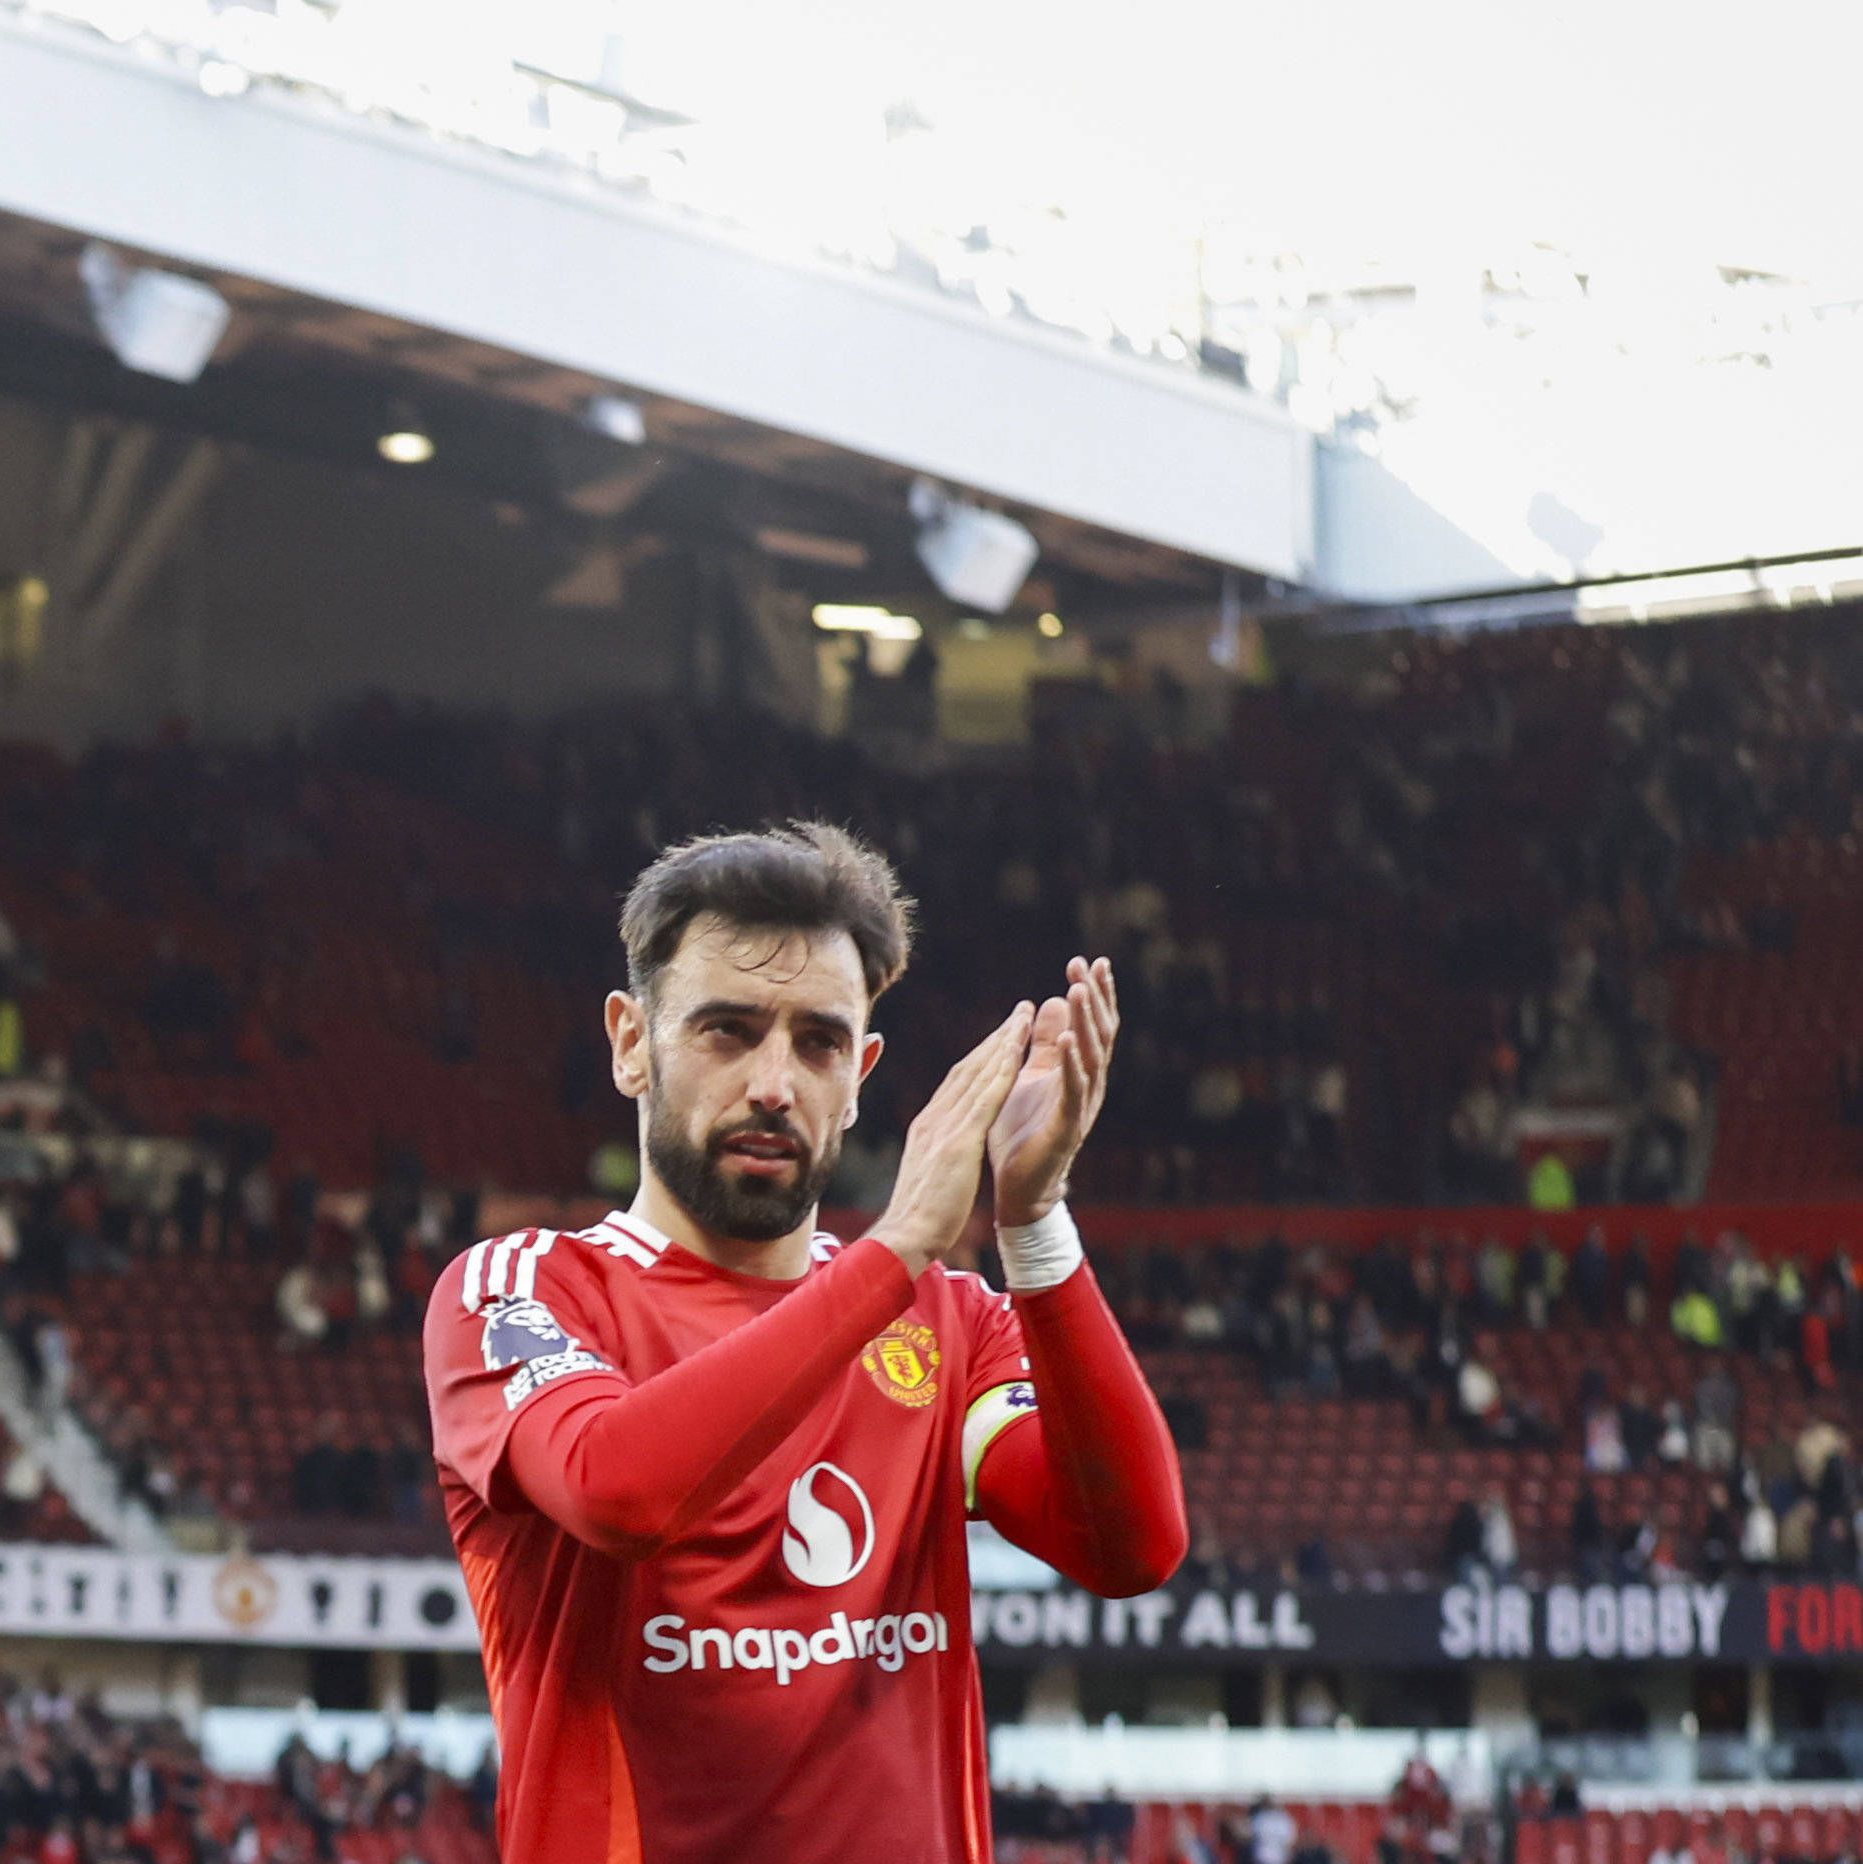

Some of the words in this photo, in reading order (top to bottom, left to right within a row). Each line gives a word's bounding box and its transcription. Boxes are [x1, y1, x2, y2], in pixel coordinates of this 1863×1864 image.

[643, 1611, 949, 1686] Snapdrgon
[1181, 1592, 1315, 1649] ALL
[1440, 1582, 1533, 1659] SIR
[1547, 1582, 1726, 1659] BOBBY
